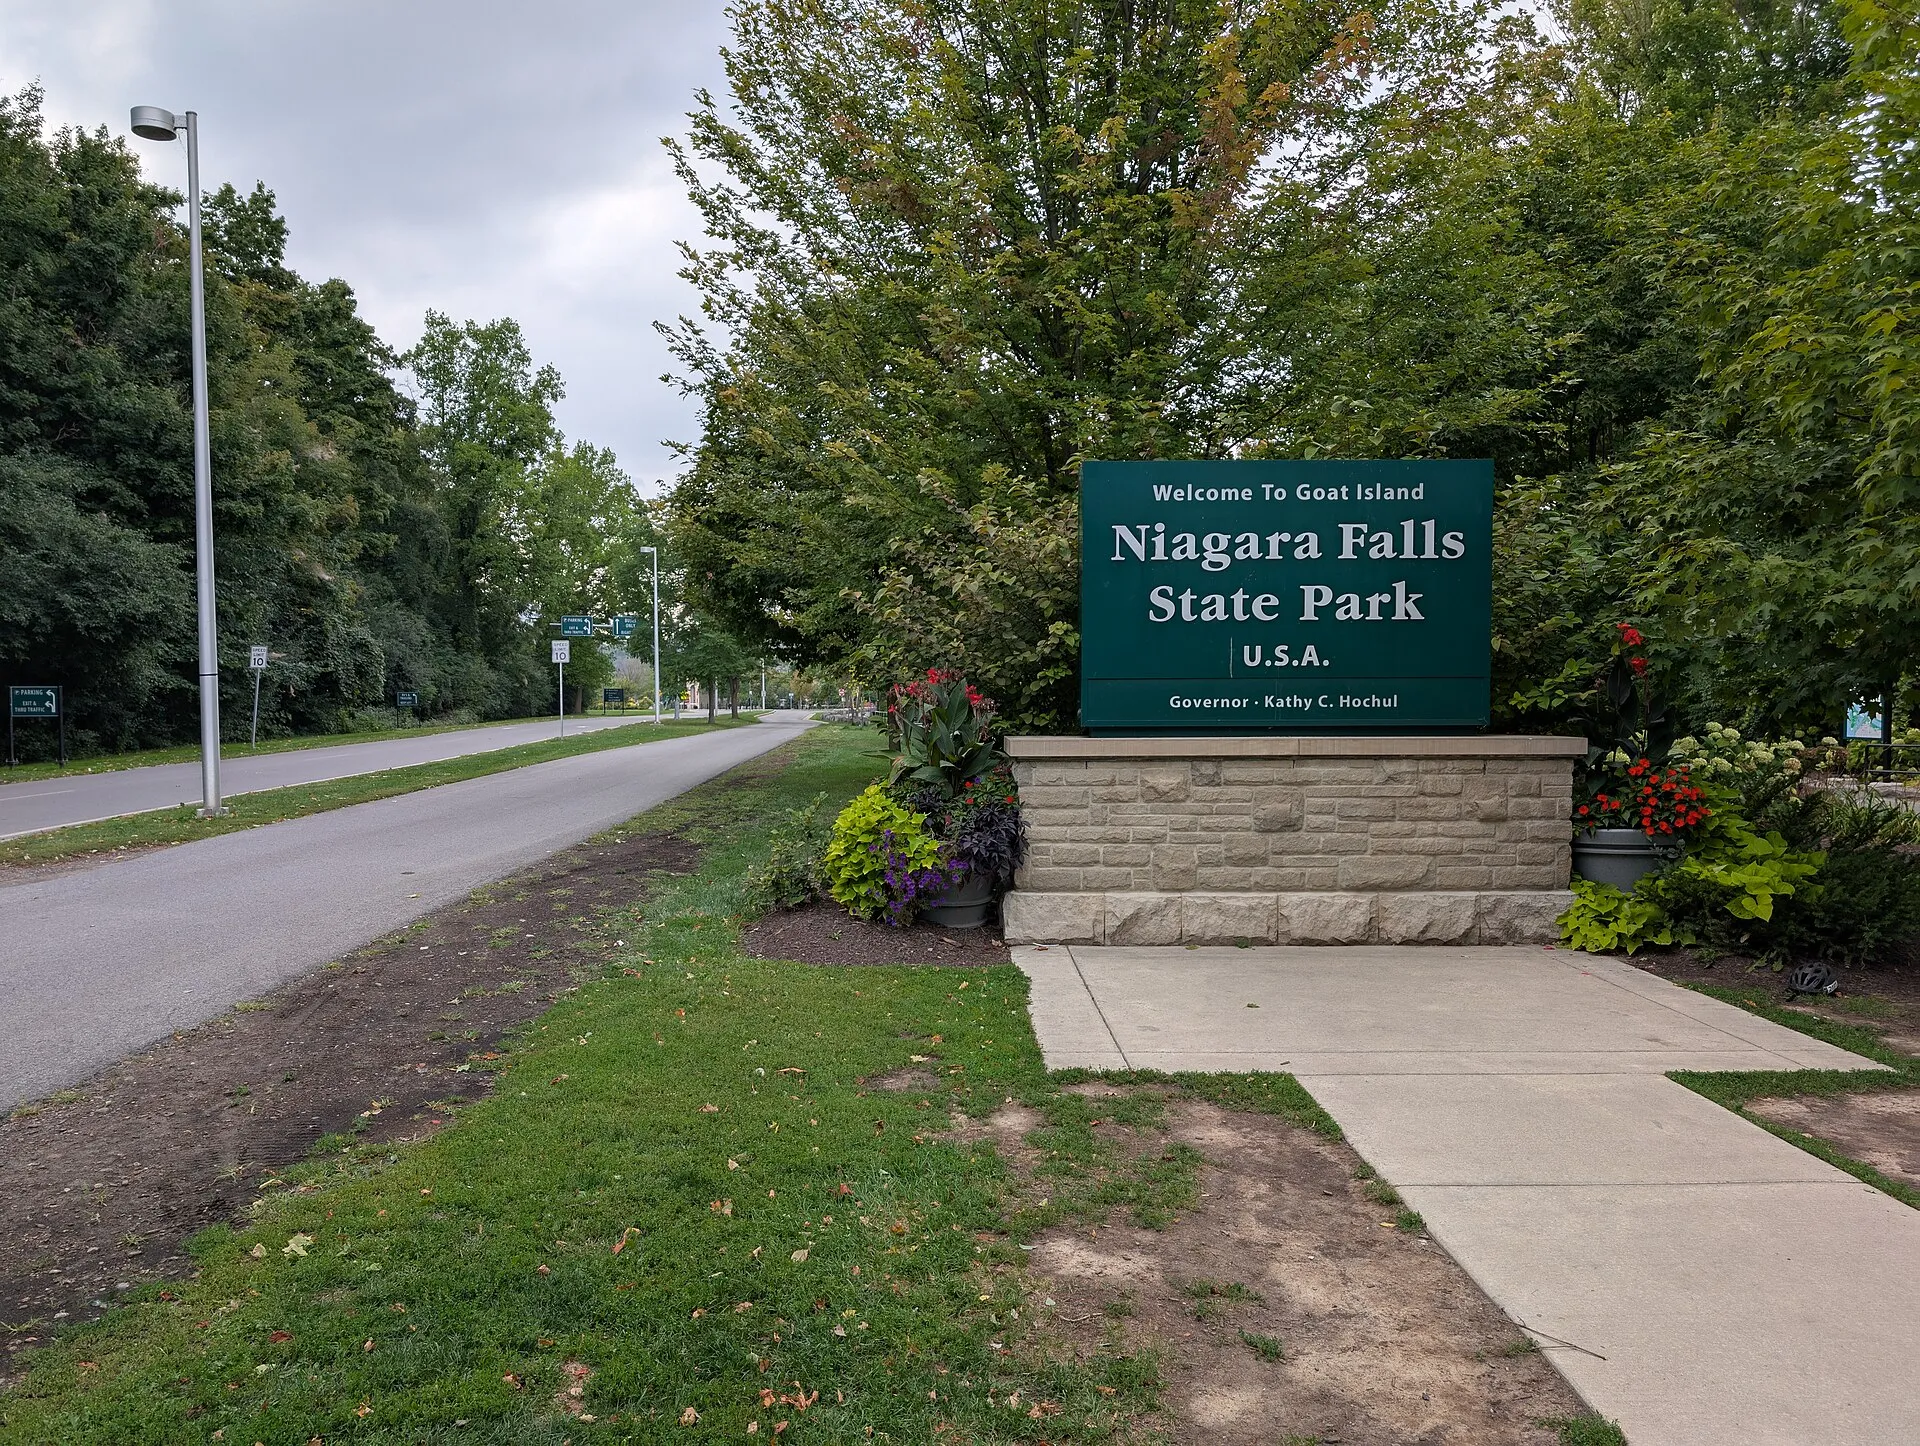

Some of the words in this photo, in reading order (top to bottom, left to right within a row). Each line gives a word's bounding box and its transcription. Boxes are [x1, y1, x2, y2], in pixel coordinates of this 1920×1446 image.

[1152, 483, 1253, 501] Welcome
[1261, 484, 1287, 501] To
[1295, 483, 1349, 501] Goat
[1356, 483, 1424, 501] Island
[1110, 522, 1323, 572] Niagara
[1337, 519, 1465, 559] Falls
[1149, 585, 1280, 622] State
[1299, 580, 1425, 621] Park
[253, 658, 264, 666] 10
[555, 652, 566, 660] 10
[1243, 644, 1330, 667] U.S.A.
[1169, 695, 1249, 708] Governor
[1264, 694, 1313, 711] Kathy
[1318, 695, 1334, 708] C.
[1339, 694, 1398, 708] Hochul
